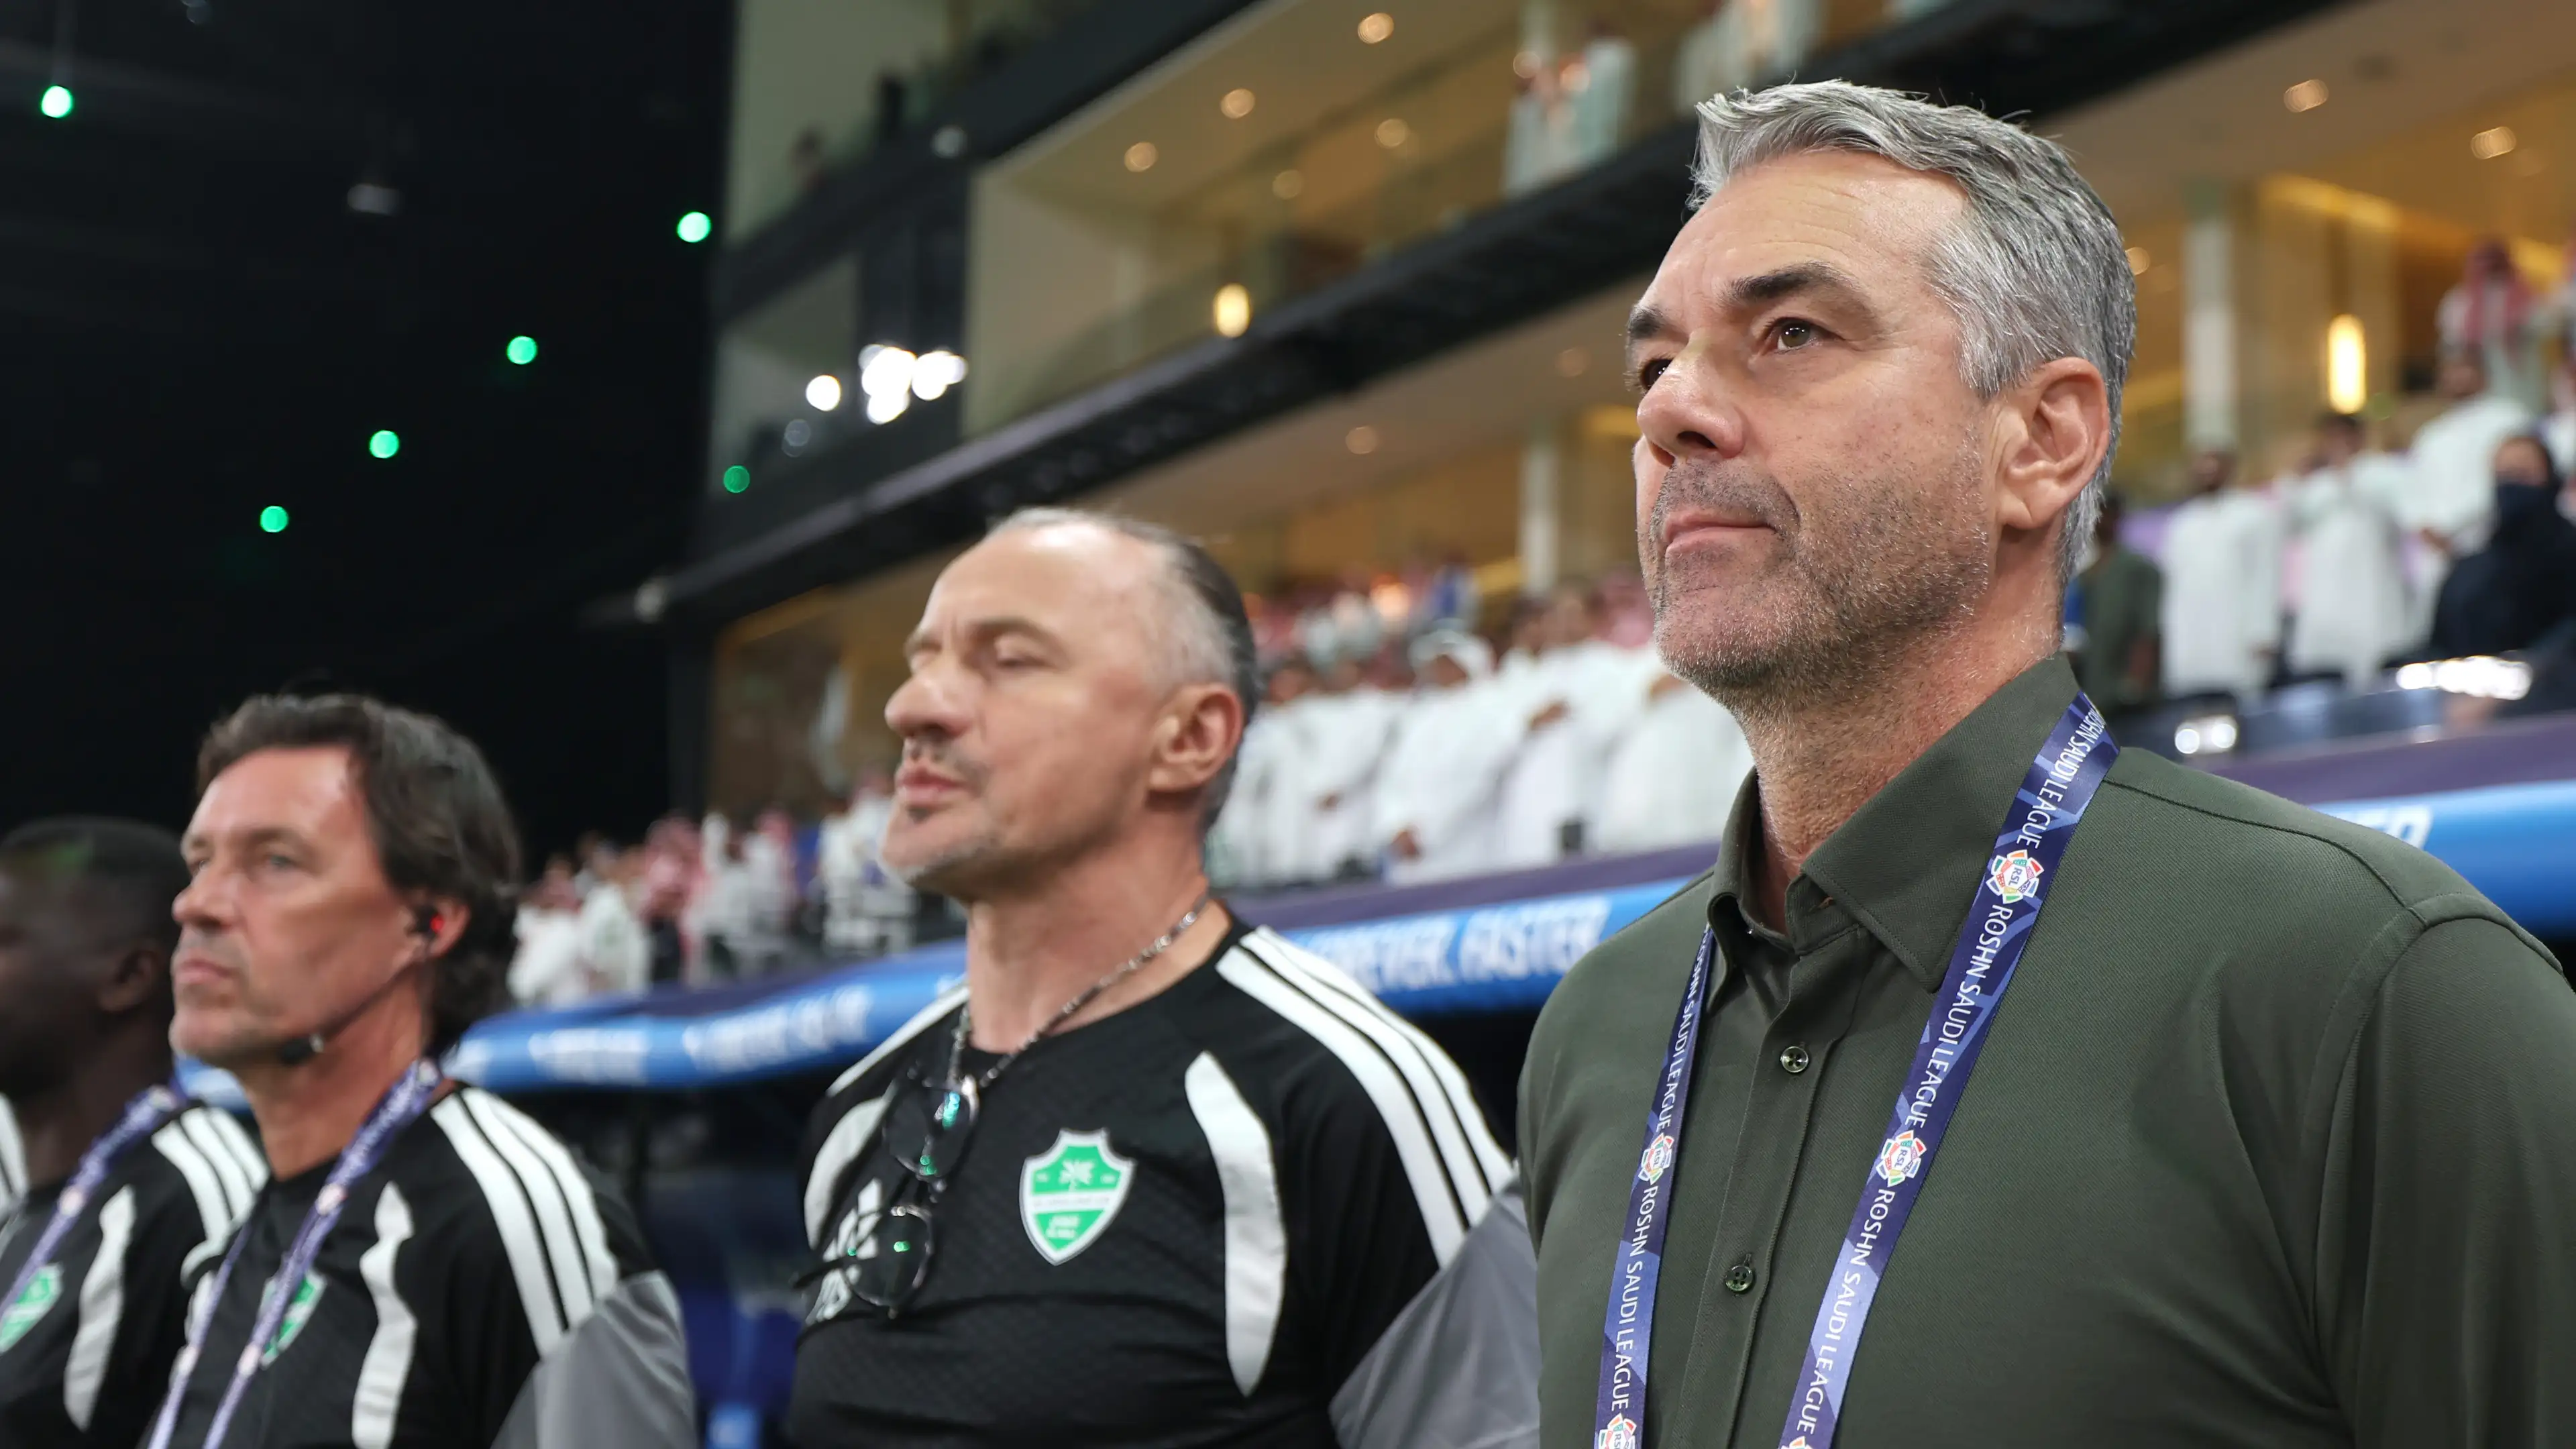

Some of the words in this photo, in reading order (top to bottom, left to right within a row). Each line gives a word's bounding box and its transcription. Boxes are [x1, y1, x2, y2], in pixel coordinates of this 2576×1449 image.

[2051, 736, 2091, 783] SAUDI
[2016, 779, 2069, 849] LEAGUE
[2008, 867, 2023, 885] RSL
[1966, 904, 2013, 979] ROSHN
[1672, 1000, 1695, 1058] SAUDI
[1938, 981, 1981, 1045] SAUDI
[1656, 1058, 1682, 1133] LEAGUE
[1904, 1047, 1954, 1129] LEAGUE
[1894, 1148, 1909, 1167] RSL
[1629, 1185, 1659, 1257] ROSHN
[1849, 1189, 1896, 1267] ROSHN
[1619, 1260, 1643, 1325] SAUDI
[1825, 1271, 1861, 1341] SAUDI
[1611, 1328, 1634, 1411] LEAGUE
[1796, 1345, 1837, 1435] LEAGUE
